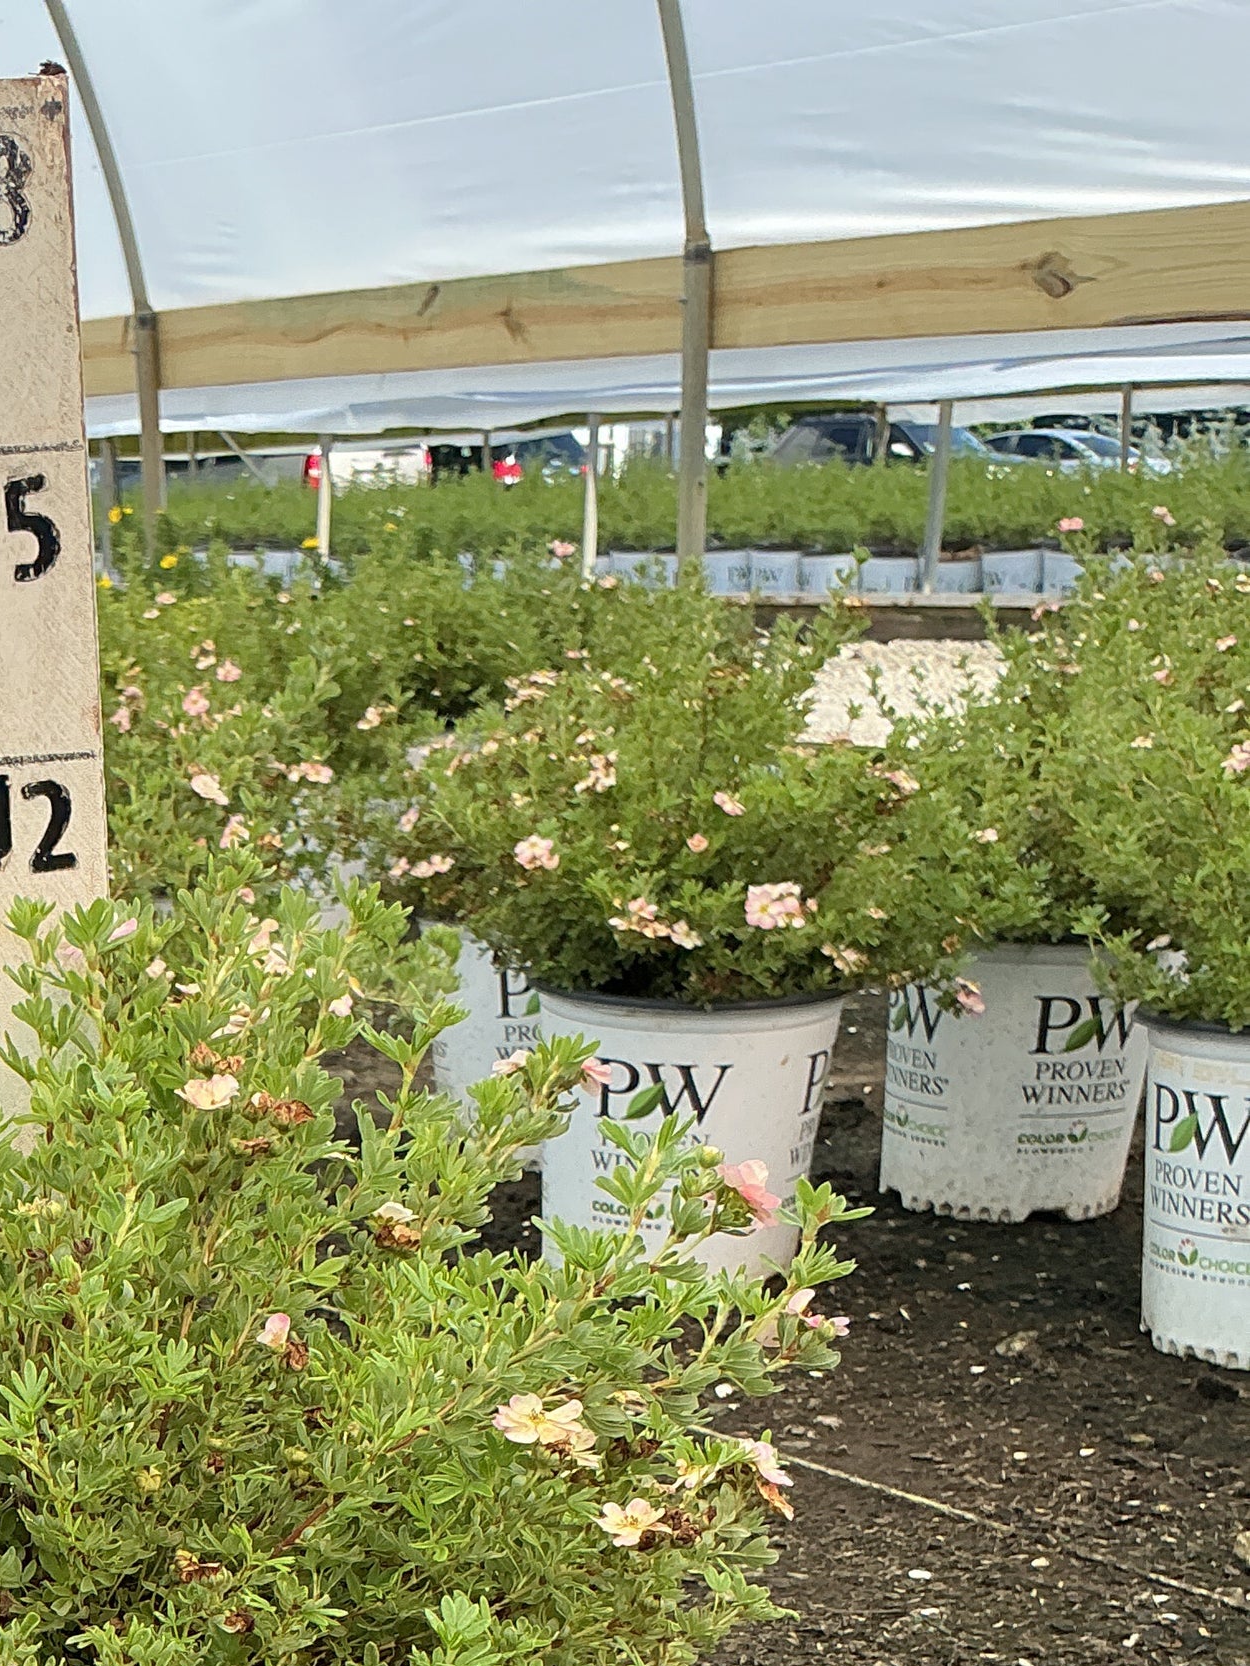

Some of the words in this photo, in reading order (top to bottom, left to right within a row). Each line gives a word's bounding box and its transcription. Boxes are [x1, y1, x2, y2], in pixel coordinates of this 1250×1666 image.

[1036, 1057, 1126, 1081] PROVEN
[593, 1056, 734, 1127] PW
[1153, 1082, 1250, 1166] PW
[1155, 1159, 1243, 1197] PROVEN
[592, 1200, 631, 1216] COLO
